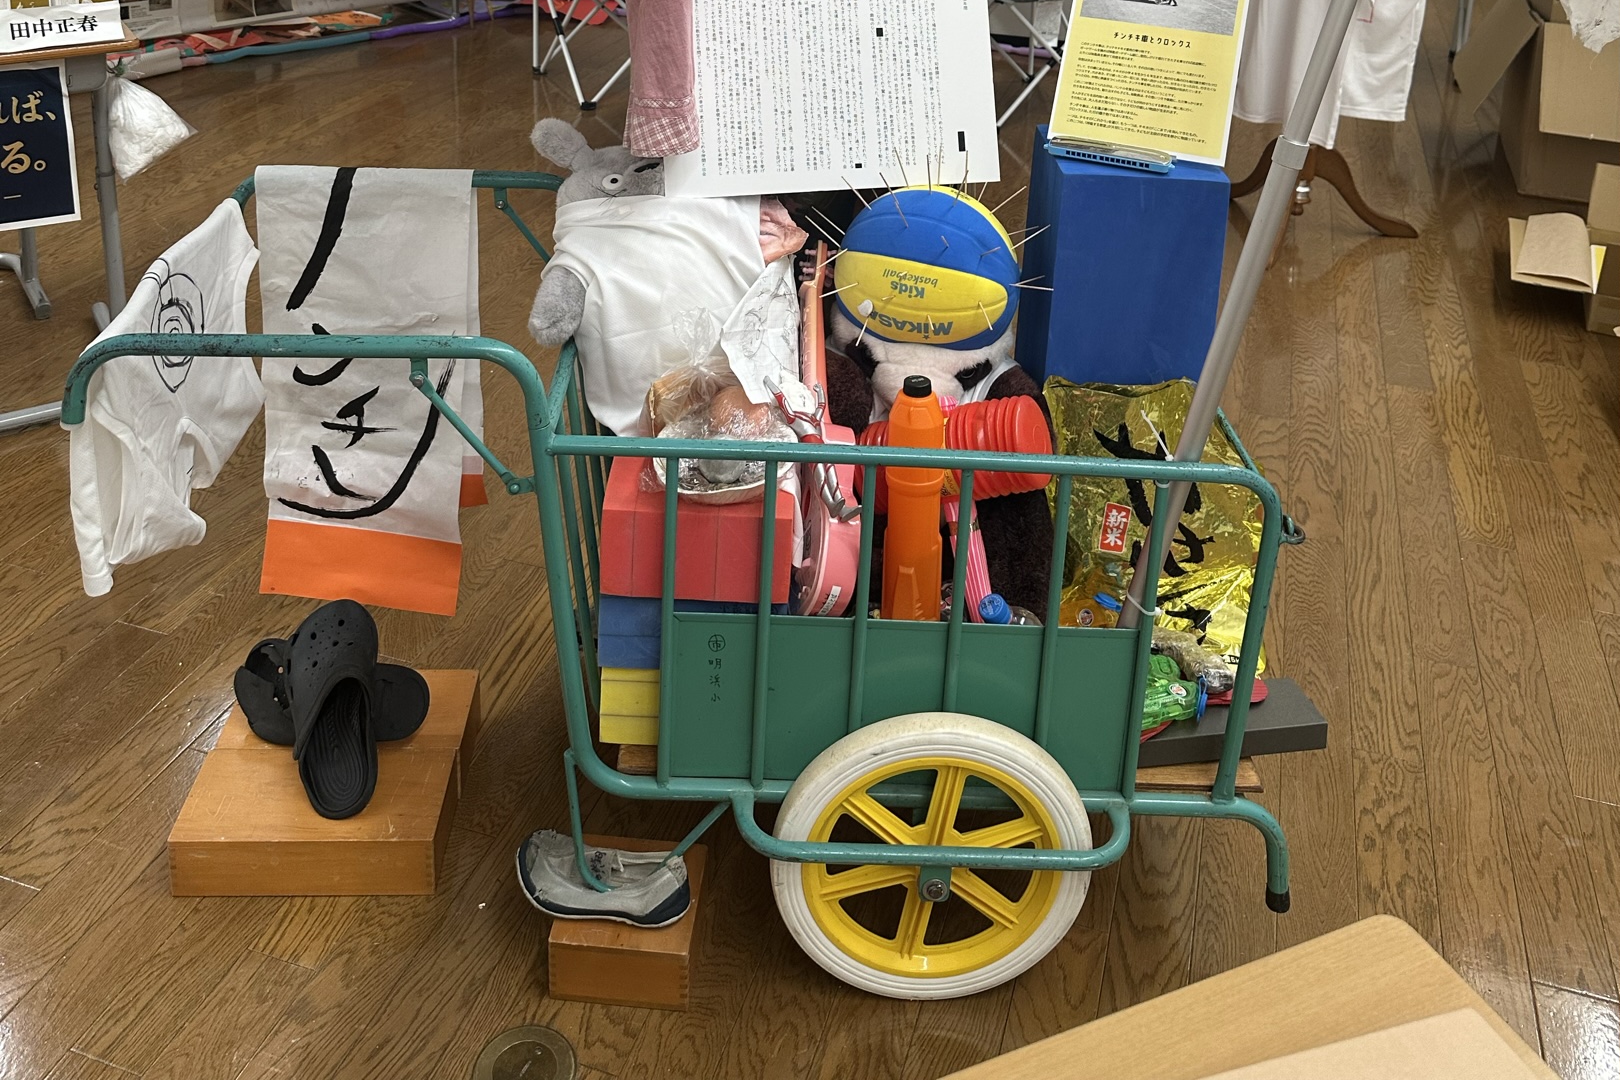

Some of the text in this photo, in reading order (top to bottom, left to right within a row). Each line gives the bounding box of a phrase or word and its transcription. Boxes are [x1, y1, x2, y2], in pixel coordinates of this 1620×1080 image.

[10, 15, 99, 41] 田中正春
[1113, 32, 1191, 49] チンチキ車とクロックス
[890, 280, 926, 299] Kids
[1105, 508, 1127, 547] 新米
[708, 658, 723, 702] 明浜小
